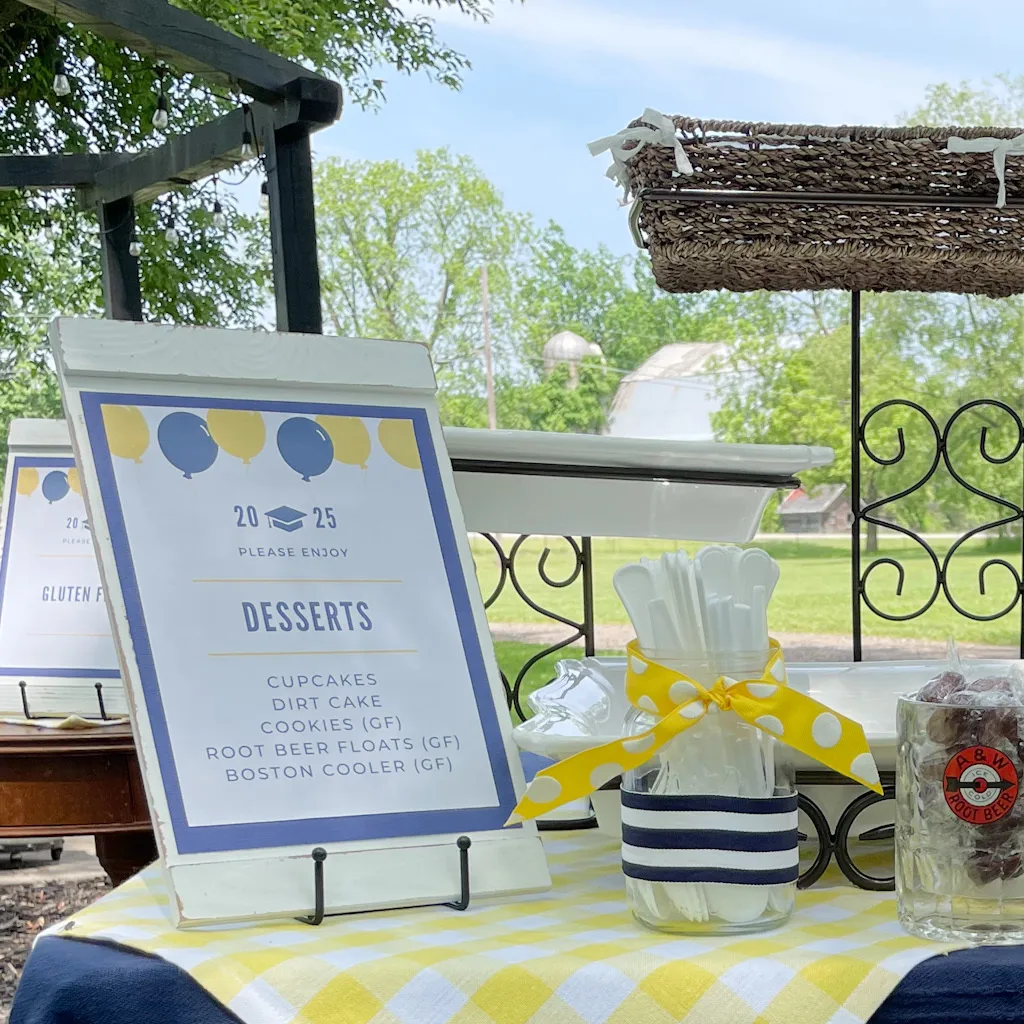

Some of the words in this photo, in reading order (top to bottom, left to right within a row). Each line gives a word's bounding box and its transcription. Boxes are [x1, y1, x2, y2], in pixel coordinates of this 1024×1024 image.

[66, 517, 79, 529] 20
[234, 505, 259, 528] 20
[313, 507, 337, 529] 25
[238, 547, 296, 557] PLEASE
[301, 547, 348, 558] ENJOY
[42, 585, 91, 602] GLUTEN
[241, 601, 373, 632] DESSERTS
[267, 673, 377, 689] CUPCAKES
[272, 697, 319, 711] DIRT
[329, 695, 382, 709] CAKE
[260, 718, 354, 734] COOKIES
[362, 716, 402, 733] (GF)
[206, 744, 265, 760] ROOT
[274, 742, 329, 757] BEER
[337, 737, 414, 754] FLOATS
[422, 734, 460, 752] (GF)
[226, 765, 314, 782] BOSTON
[322, 760, 406, 777] COOLER
[414, 756, 453, 774] (GF)
[968, 790, 992, 800] COLD
[949, 794, 978, 821] ROOT
[983, 792, 1014, 821] BEER
